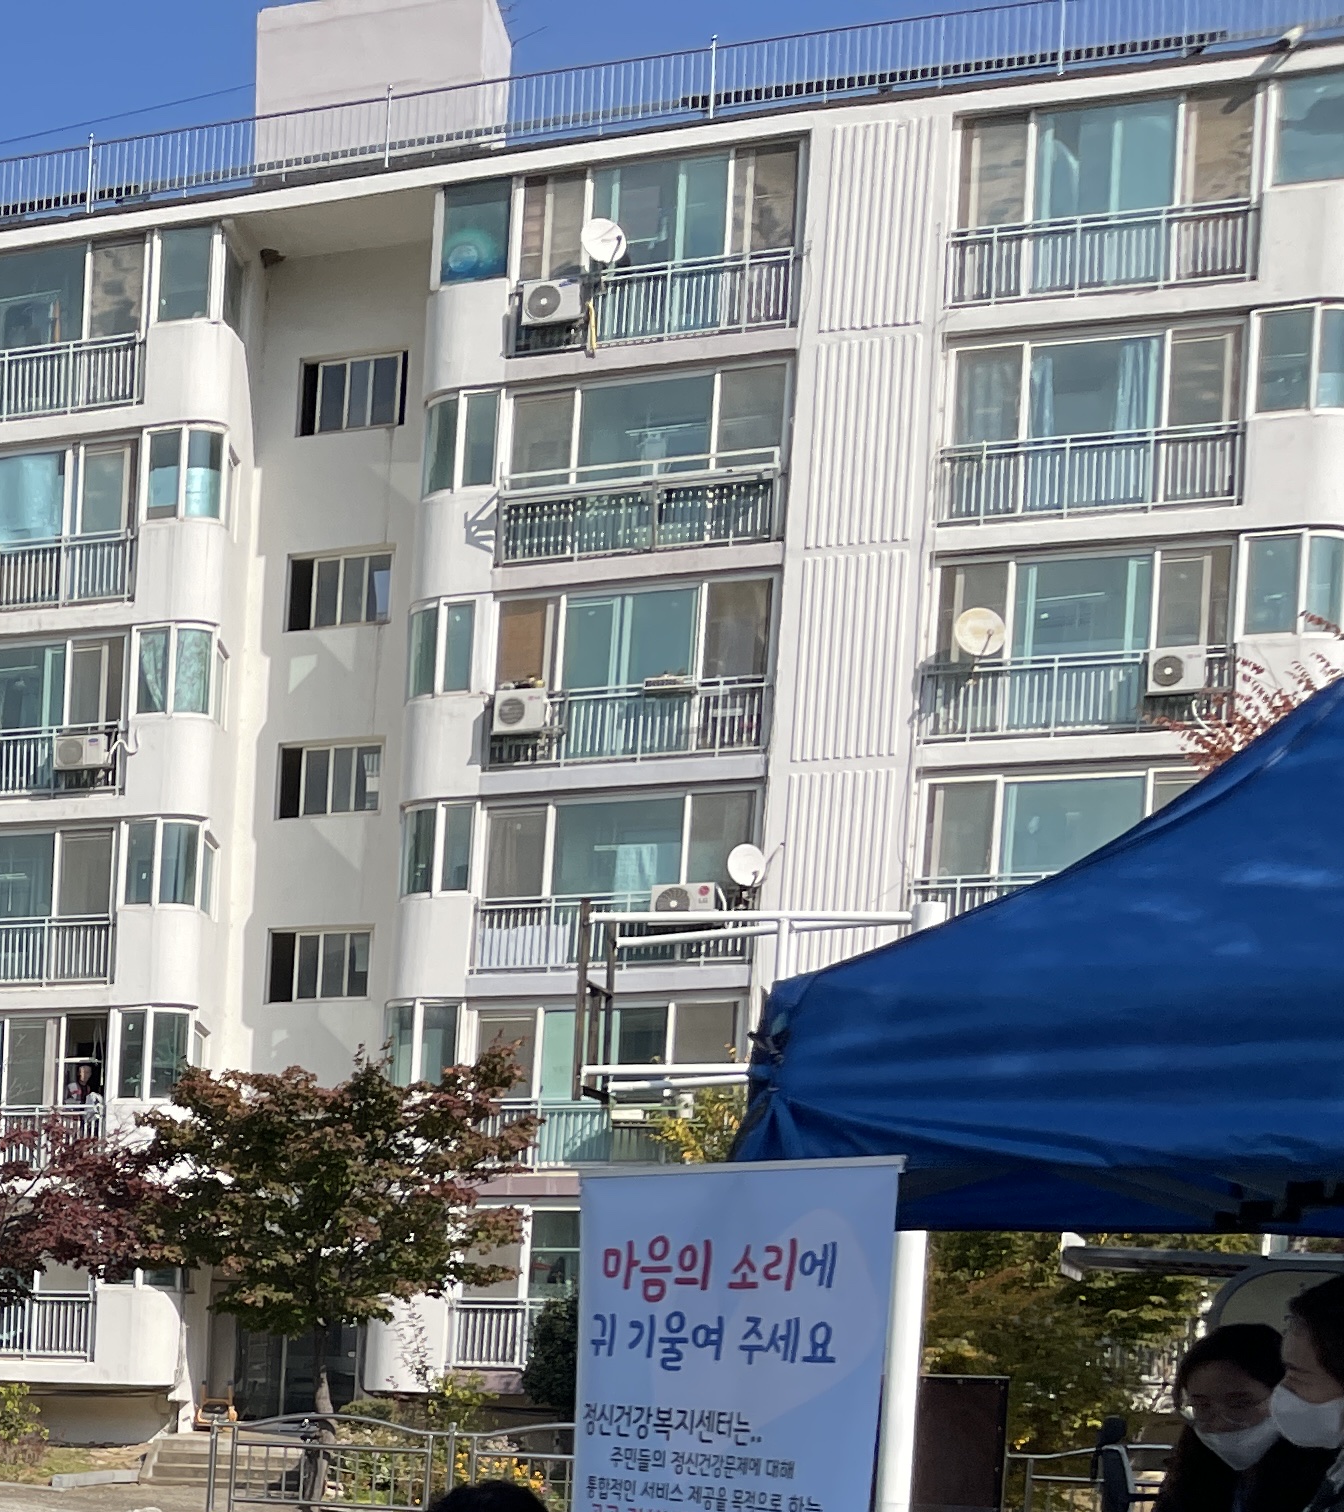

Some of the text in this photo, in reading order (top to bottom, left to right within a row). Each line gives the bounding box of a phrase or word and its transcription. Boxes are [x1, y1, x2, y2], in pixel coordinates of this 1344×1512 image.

[603, 1235, 838, 1303] 마음의 소리에
[590, 1311, 837, 1372] 귀 기울여 주세요
[583, 1403, 762, 1446] 정신건강복지센터는..
[610, 1446, 796, 1480] 주민들의 정신건강문제에 대해
[586, 1475, 637, 1502] 통합적인
[640, 1482, 684, 1502] 서비스
[688, 1485, 728, 1512] 제공을
